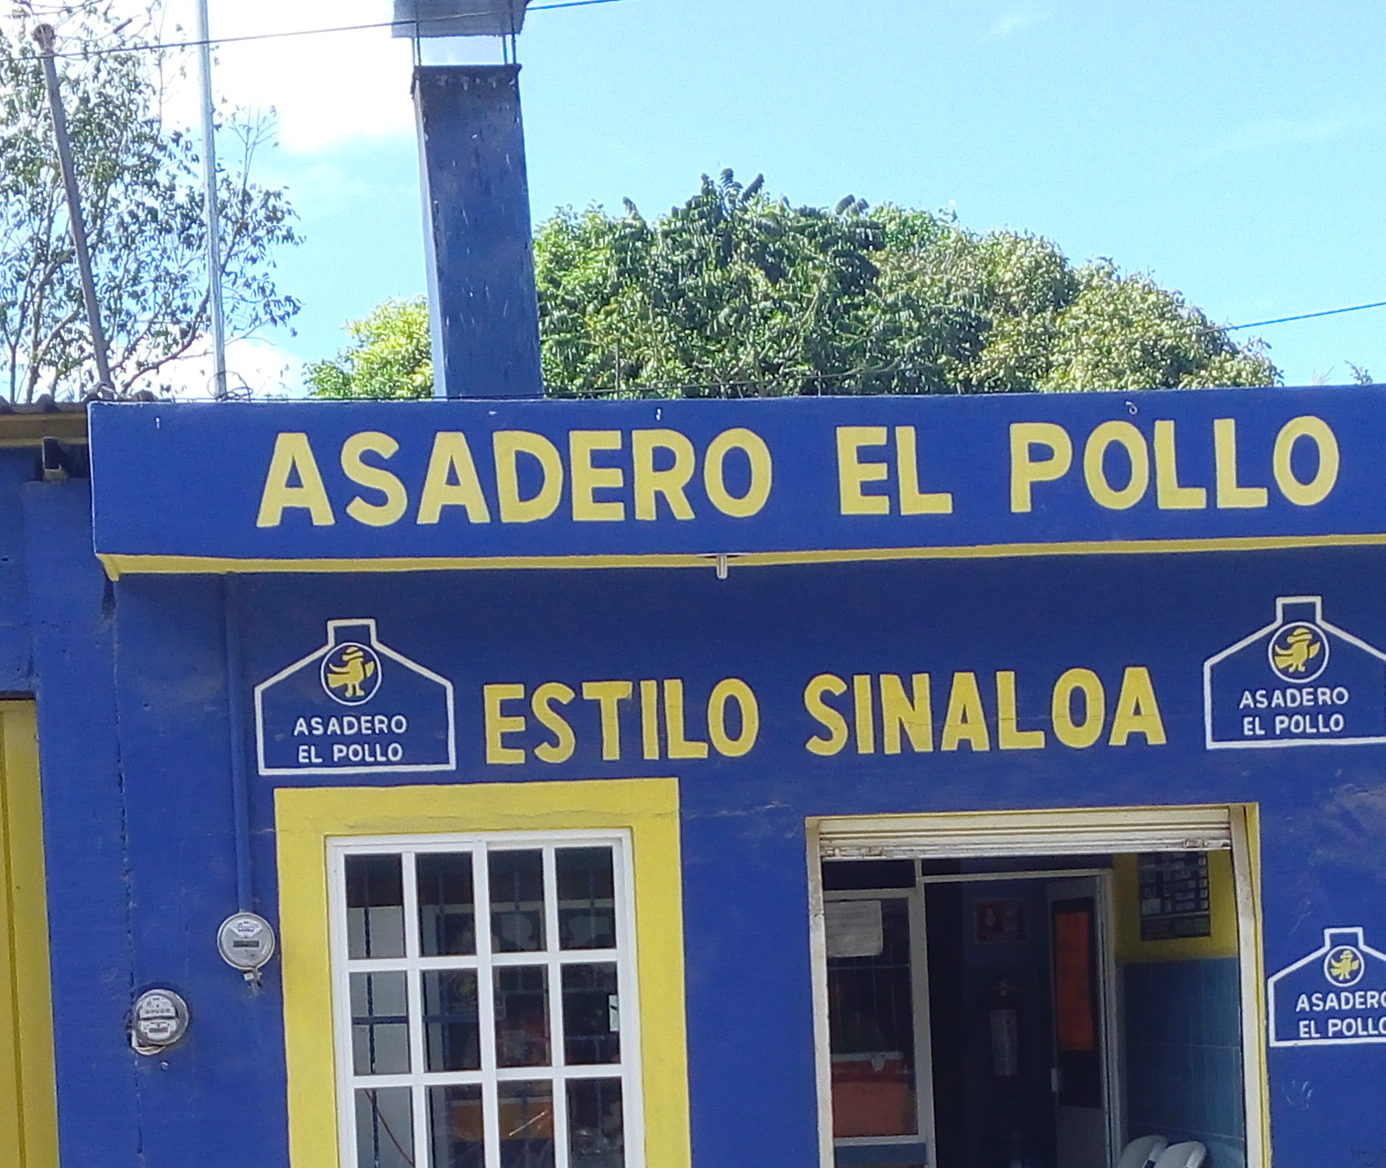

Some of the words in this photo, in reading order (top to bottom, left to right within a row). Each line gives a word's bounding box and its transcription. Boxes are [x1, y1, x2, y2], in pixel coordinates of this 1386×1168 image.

[256, 428, 772, 527] ASADERO
[836, 425, 953, 516] EL
[1009, 416, 1340, 513] POLLO
[1238, 685, 1350, 709] ASADERO
[293, 714, 408, 736] ASADERO
[483, 678, 759, 764] ESTILO
[803, 666, 1167, 756] SINALOA
[1242, 715, 1265, 735] EL
[1274, 713, 1345, 734] POLLO
[298, 745, 323, 763] EL
[333, 742, 403, 762] POLLO
[1299, 1020, 1320, 1038] EL
